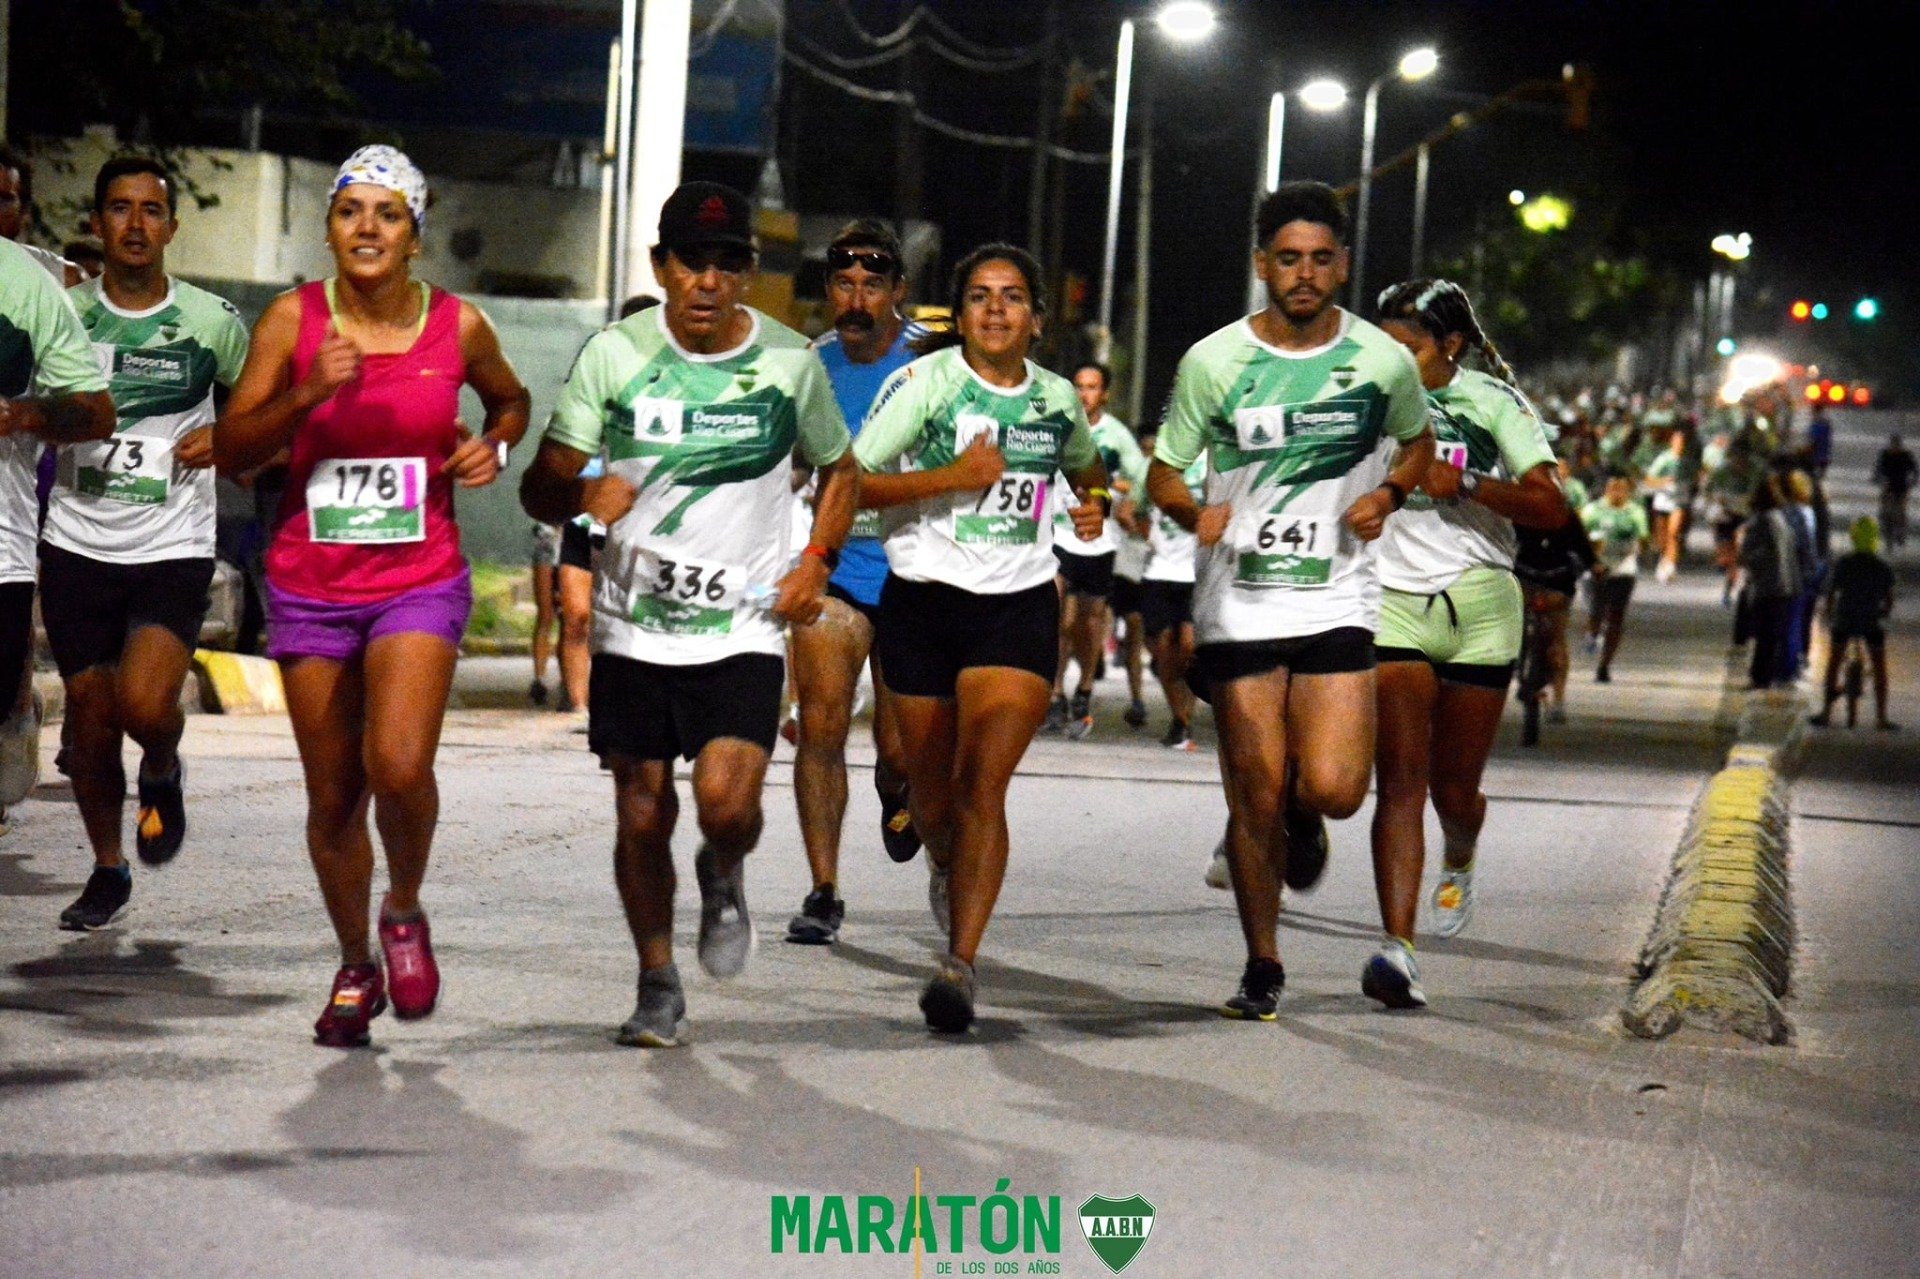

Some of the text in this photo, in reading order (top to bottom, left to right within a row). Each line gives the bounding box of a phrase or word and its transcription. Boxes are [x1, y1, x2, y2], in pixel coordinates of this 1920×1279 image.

[122, 352, 180, 370] Deportes
[692, 411, 759, 427] Deportes
[1292, 410, 1357, 425] Deportes
[1006, 424, 1055, 443] Deportes
[102, 437, 144, 470] 73
[335, 463, 398, 505] 178
[1257, 517, 1318, 551] 641
[652, 558, 727, 602] 336
